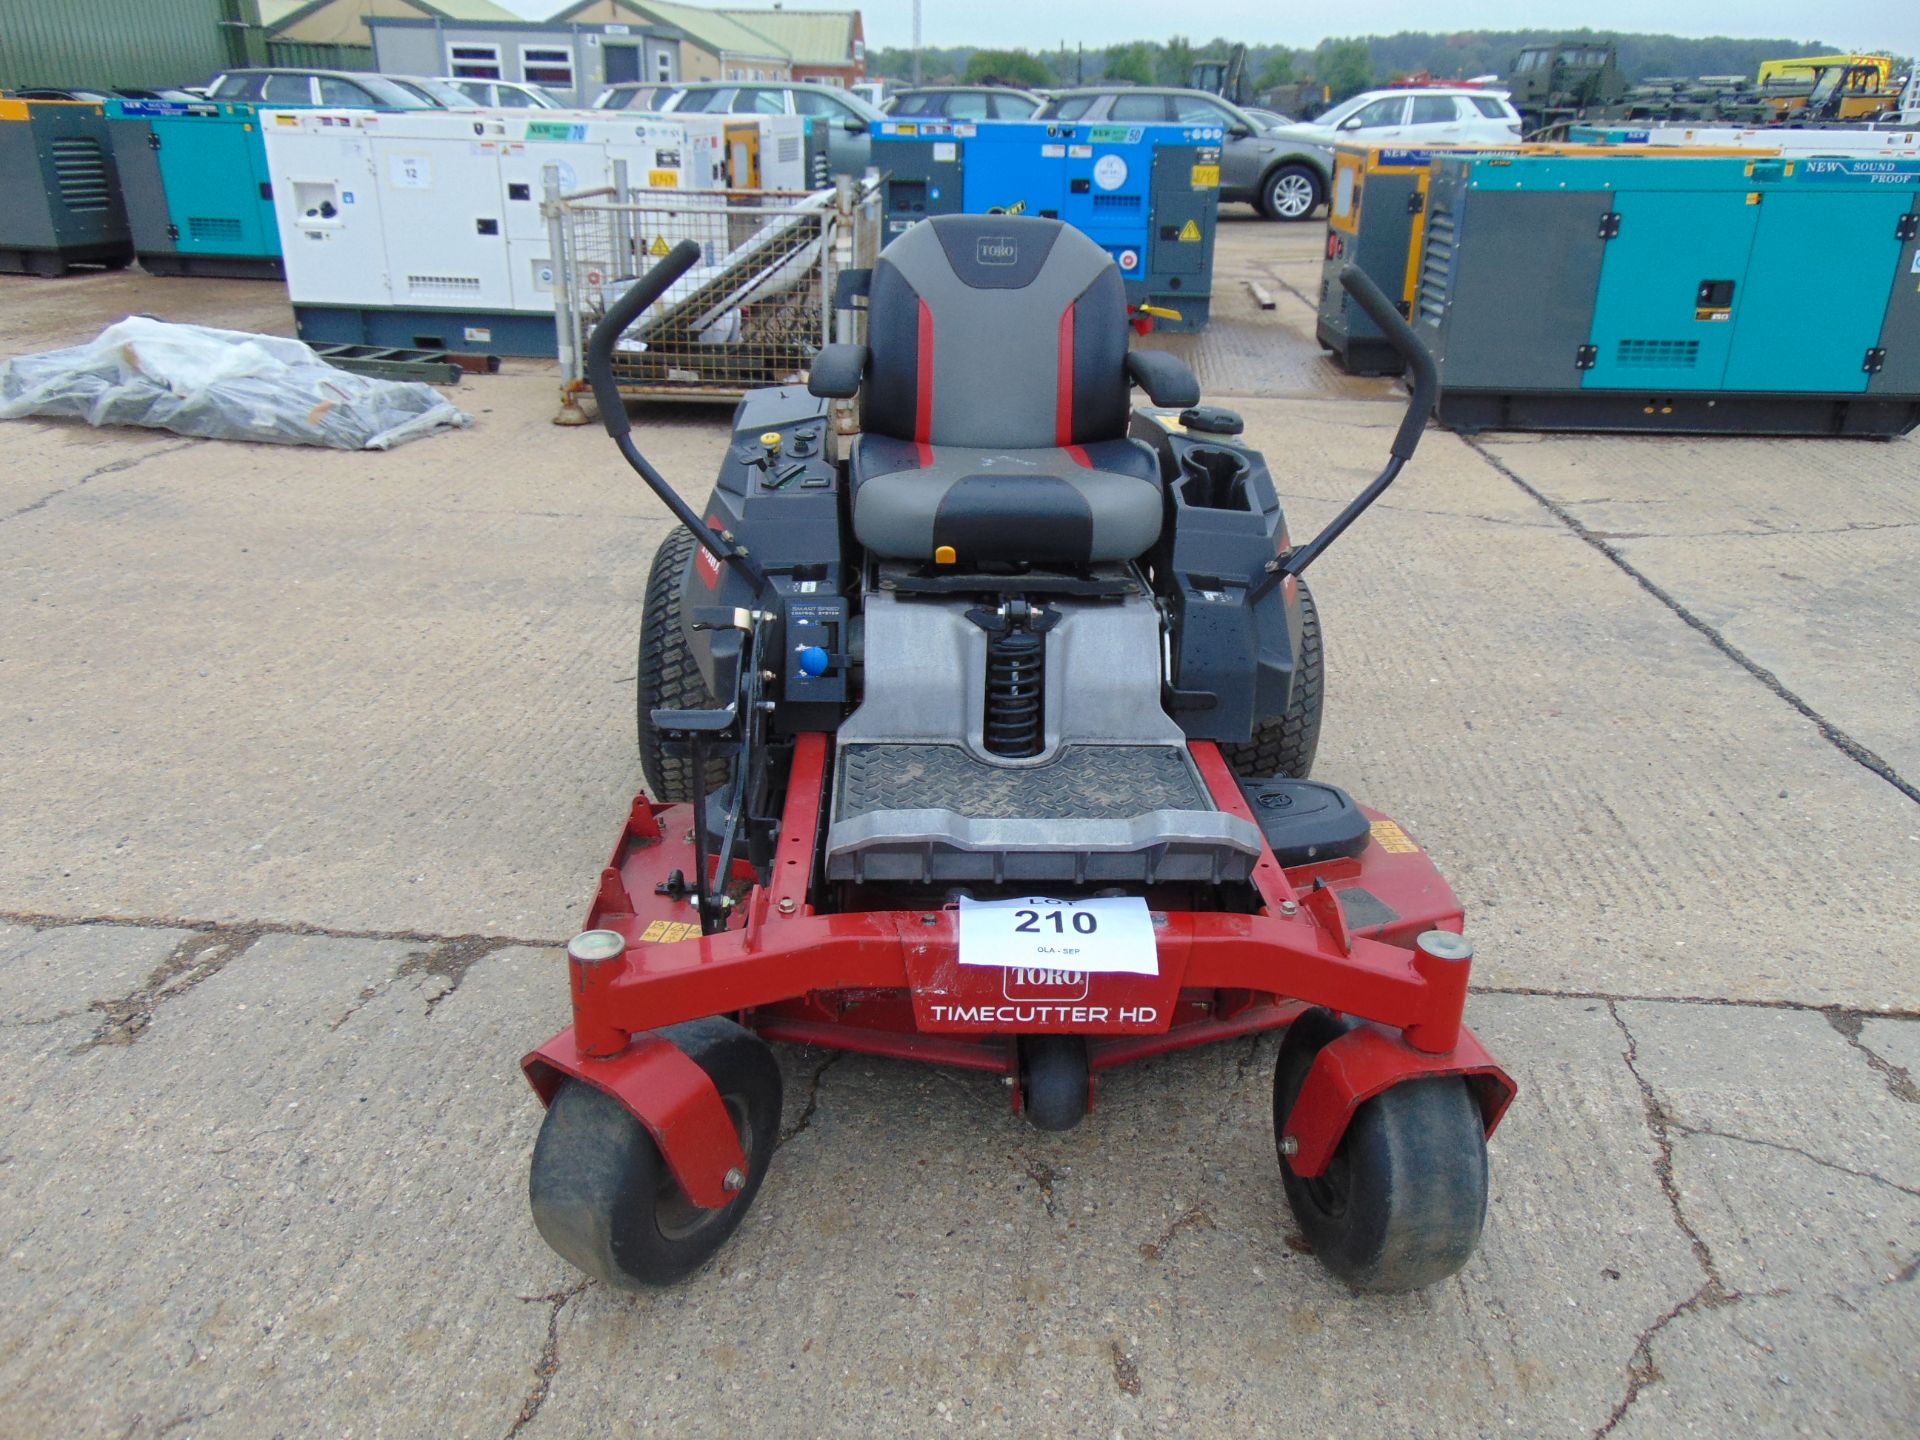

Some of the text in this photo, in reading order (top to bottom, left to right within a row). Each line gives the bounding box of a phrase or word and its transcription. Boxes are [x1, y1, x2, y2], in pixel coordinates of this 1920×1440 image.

[1128, 129, 1141, 142] 50
[1384, 149, 1408, 158] NEW
[405, 168, 417, 178] 12
[1806, 161, 1896, 173] NEW SOUND
[1870, 174, 1912, 184] PROOF
[981, 244, 1014, 257] TORO
[1029, 898, 1077, 906] LOT
[1014, 909, 1098, 935] 210
[1037, 946, 1056, 954] OLA
[1012, 966, 1082, 986] TORO
[930, 1005, 1157, 1023] TIMECUTTER HD
